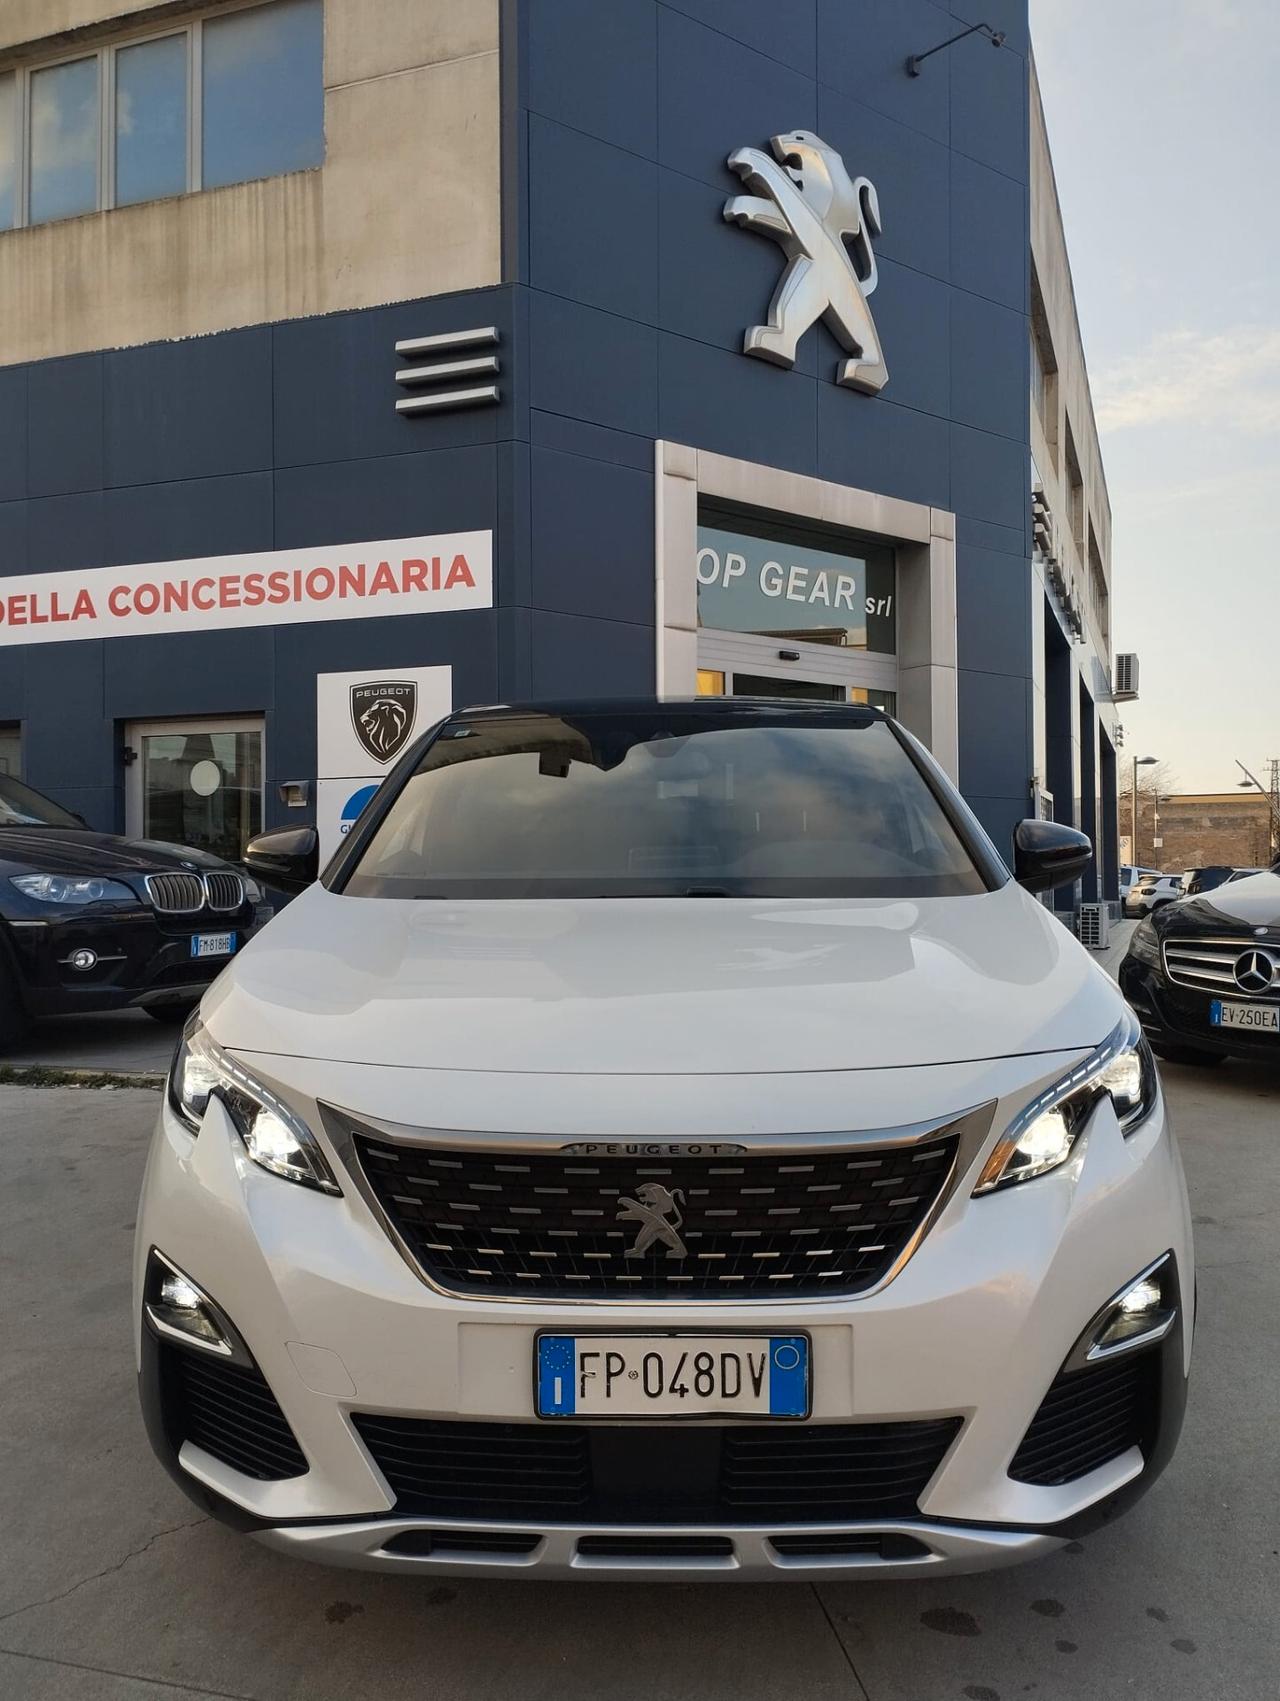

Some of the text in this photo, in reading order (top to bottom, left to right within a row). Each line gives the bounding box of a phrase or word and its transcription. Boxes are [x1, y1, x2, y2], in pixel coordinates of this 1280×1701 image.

[0, 554, 476, 626] ELLA CONCESSIONARIA
[760, 560, 856, 610] GEAR
[865, 595, 892, 617] srl
[356, 687, 411, 698] PEUGEOT
[586, 1144, 722, 1155] PEUGEOT
